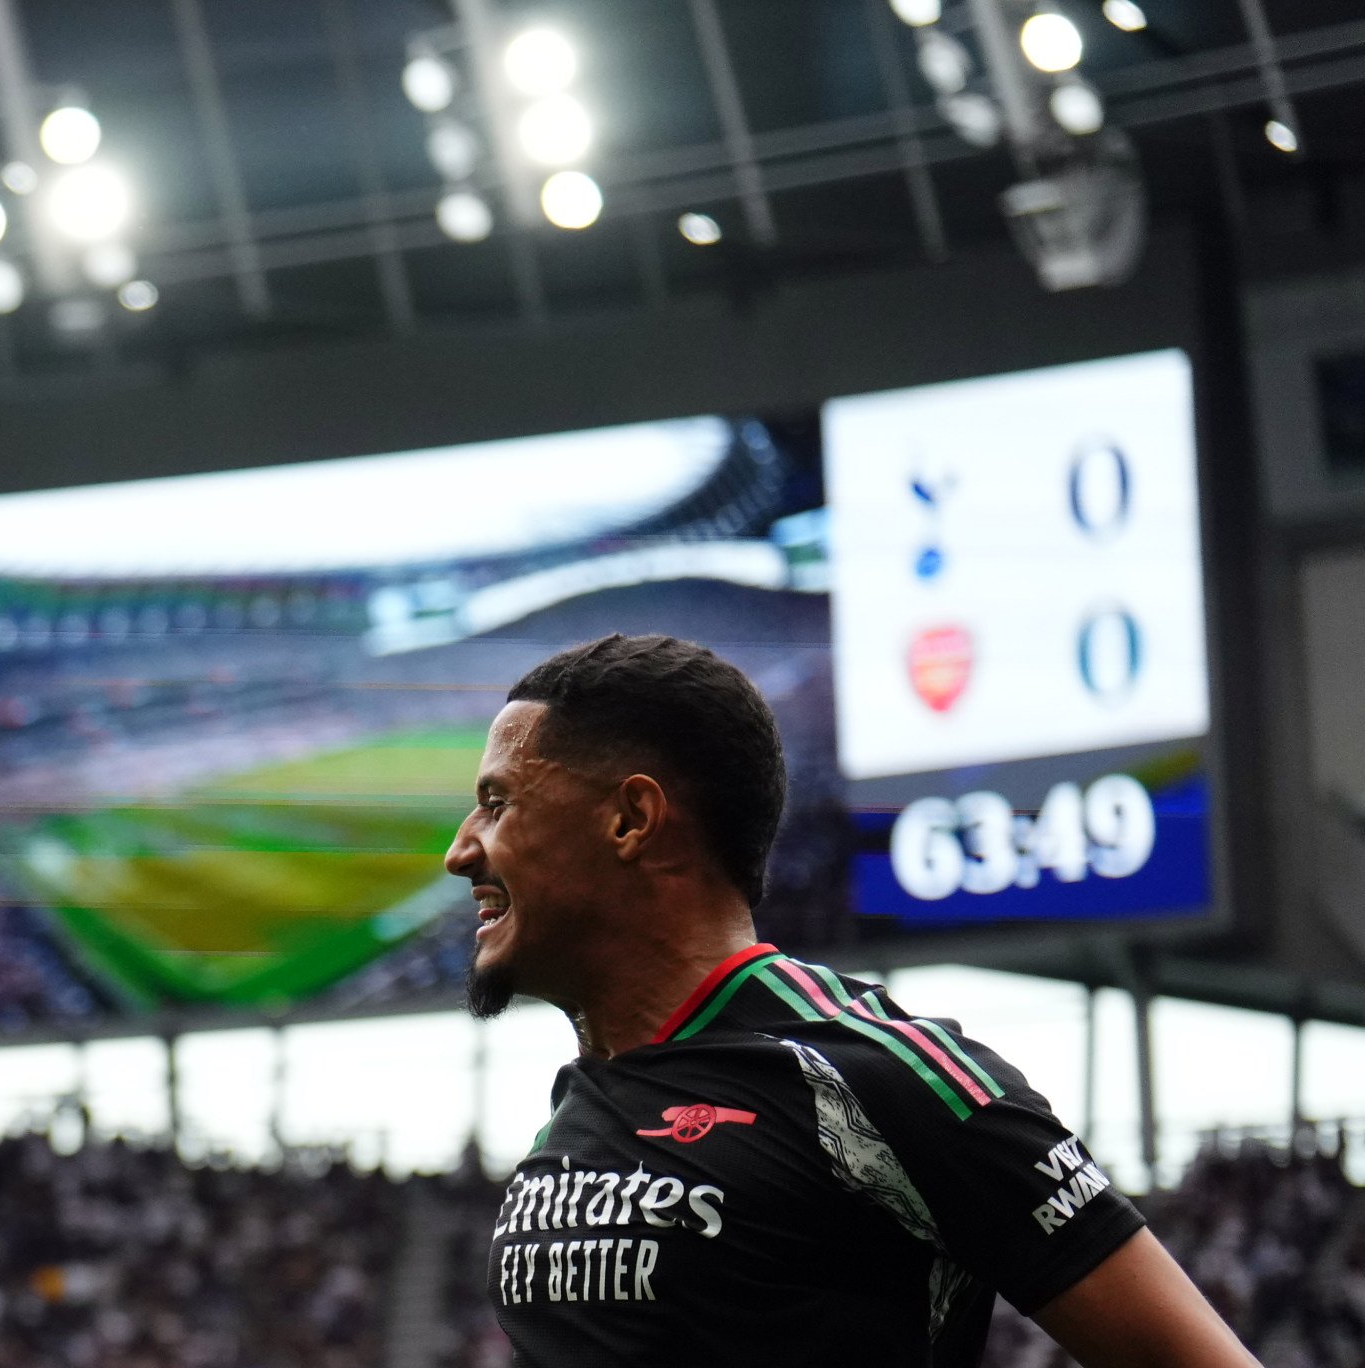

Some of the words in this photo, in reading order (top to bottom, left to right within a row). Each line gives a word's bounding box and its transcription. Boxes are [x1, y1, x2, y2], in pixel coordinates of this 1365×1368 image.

[1067, 434, 1133, 541] 0
[1076, 598, 1145, 706] 0
[890, 773, 1156, 901] 63:49
[493, 1156, 724, 1239] Emirates
[1032, 1161, 1110, 1235] RWAN
[1034, 1135, 1083, 1181] VISIT
[500, 1243, 539, 1305] FLY
[548, 1238, 659, 1302] BETTER
